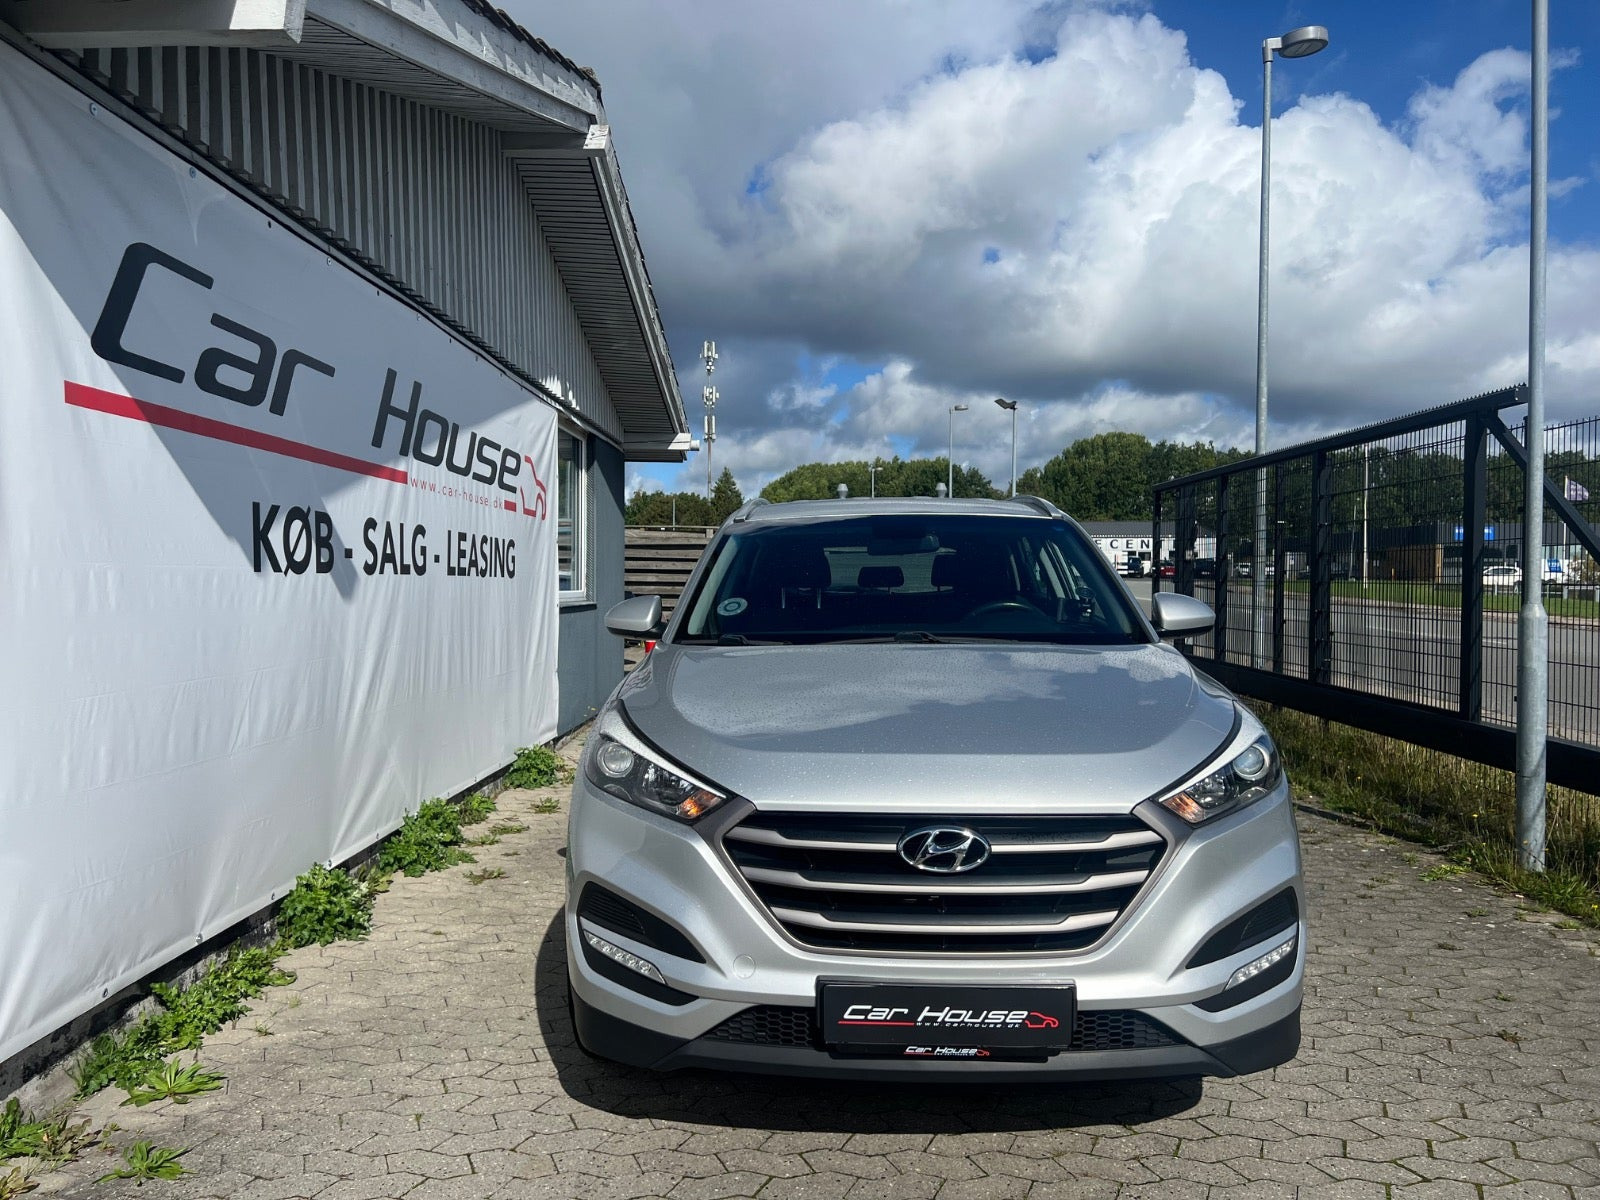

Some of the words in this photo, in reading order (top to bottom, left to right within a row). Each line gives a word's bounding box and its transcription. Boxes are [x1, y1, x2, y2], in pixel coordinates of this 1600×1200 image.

[90, 242, 336, 417] Car
[371, 368, 522, 494] House
[410, 477, 503, 510] www.car-house.dk
[252, 501, 335, 577] KØB
[363, 517, 427, 576] SALG
[447, 529, 516, 579] LEASING
[843, 1004, 909, 1021] Car
[917, 1006, 1029, 1024] House
[905, 1045, 932, 1054] Car
[934, 1046, 978, 1056] House
